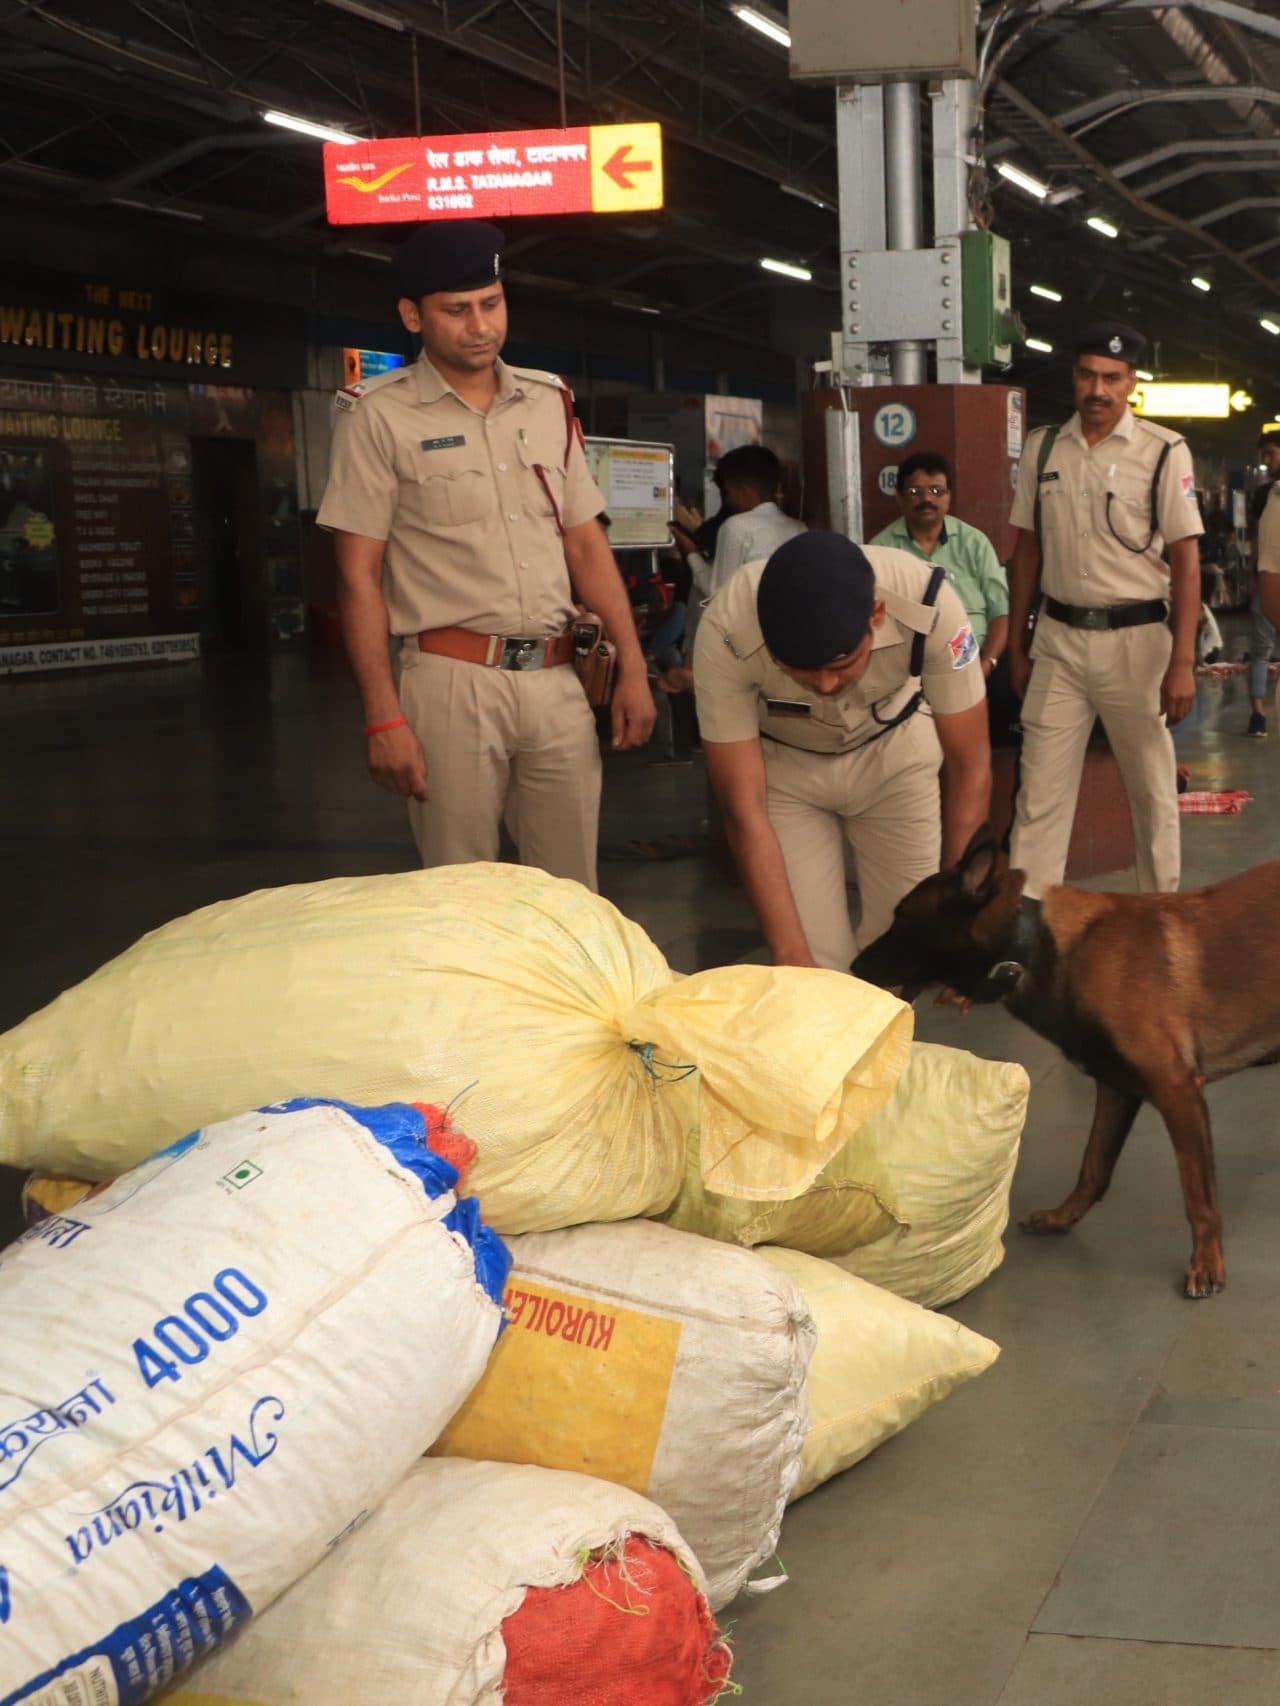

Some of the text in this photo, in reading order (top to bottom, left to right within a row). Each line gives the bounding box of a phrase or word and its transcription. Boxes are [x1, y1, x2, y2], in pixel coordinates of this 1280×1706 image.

[471, 170, 552, 189] TATANAGAR
[0, 305, 232, 368] WAITING LOUNGE
[62, 415, 122, 441] LOUNGE
[880, 413, 905, 437] 12
[131, 1267, 269, 1388] 4000
[65, 1395, 285, 1564] Milkiana
